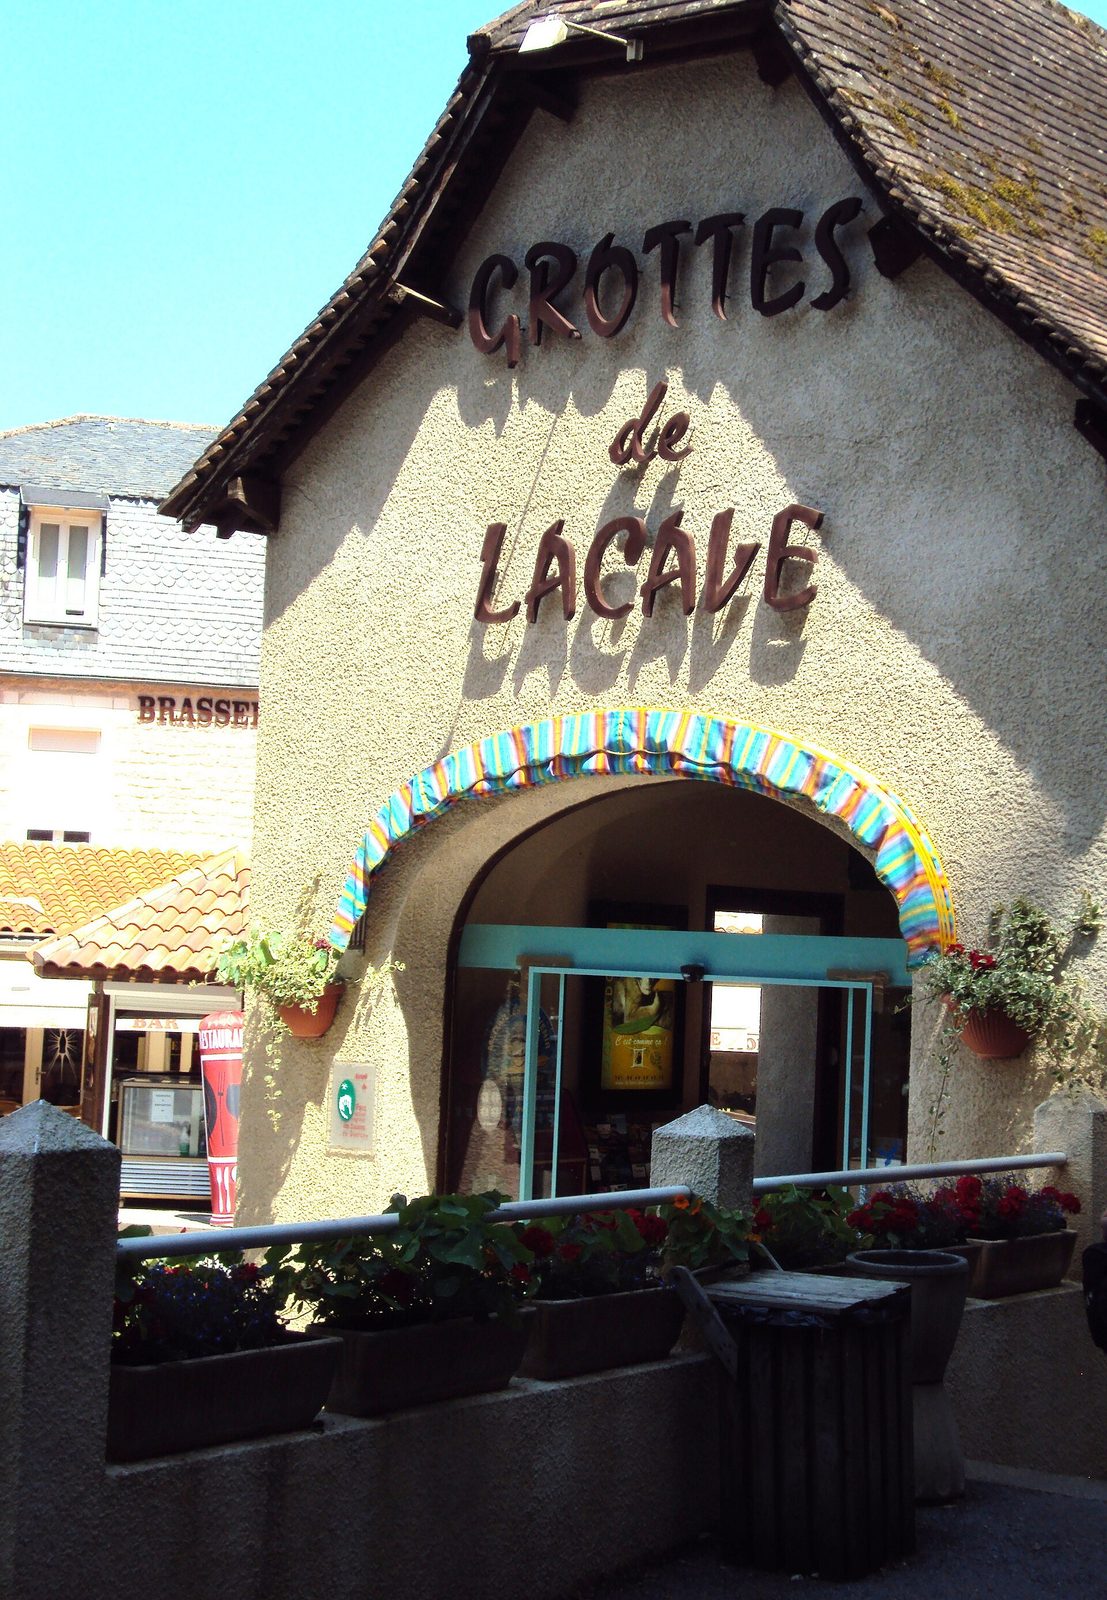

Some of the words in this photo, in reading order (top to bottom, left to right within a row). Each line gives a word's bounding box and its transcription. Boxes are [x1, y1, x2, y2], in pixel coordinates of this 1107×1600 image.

[468, 197, 863, 369] GROTTES
[609, 380, 694, 466] de
[474, 504, 826, 624] LACAVE
[133, 1017, 179, 1029] BAR
[200, 1028, 243, 1049] STAURA
